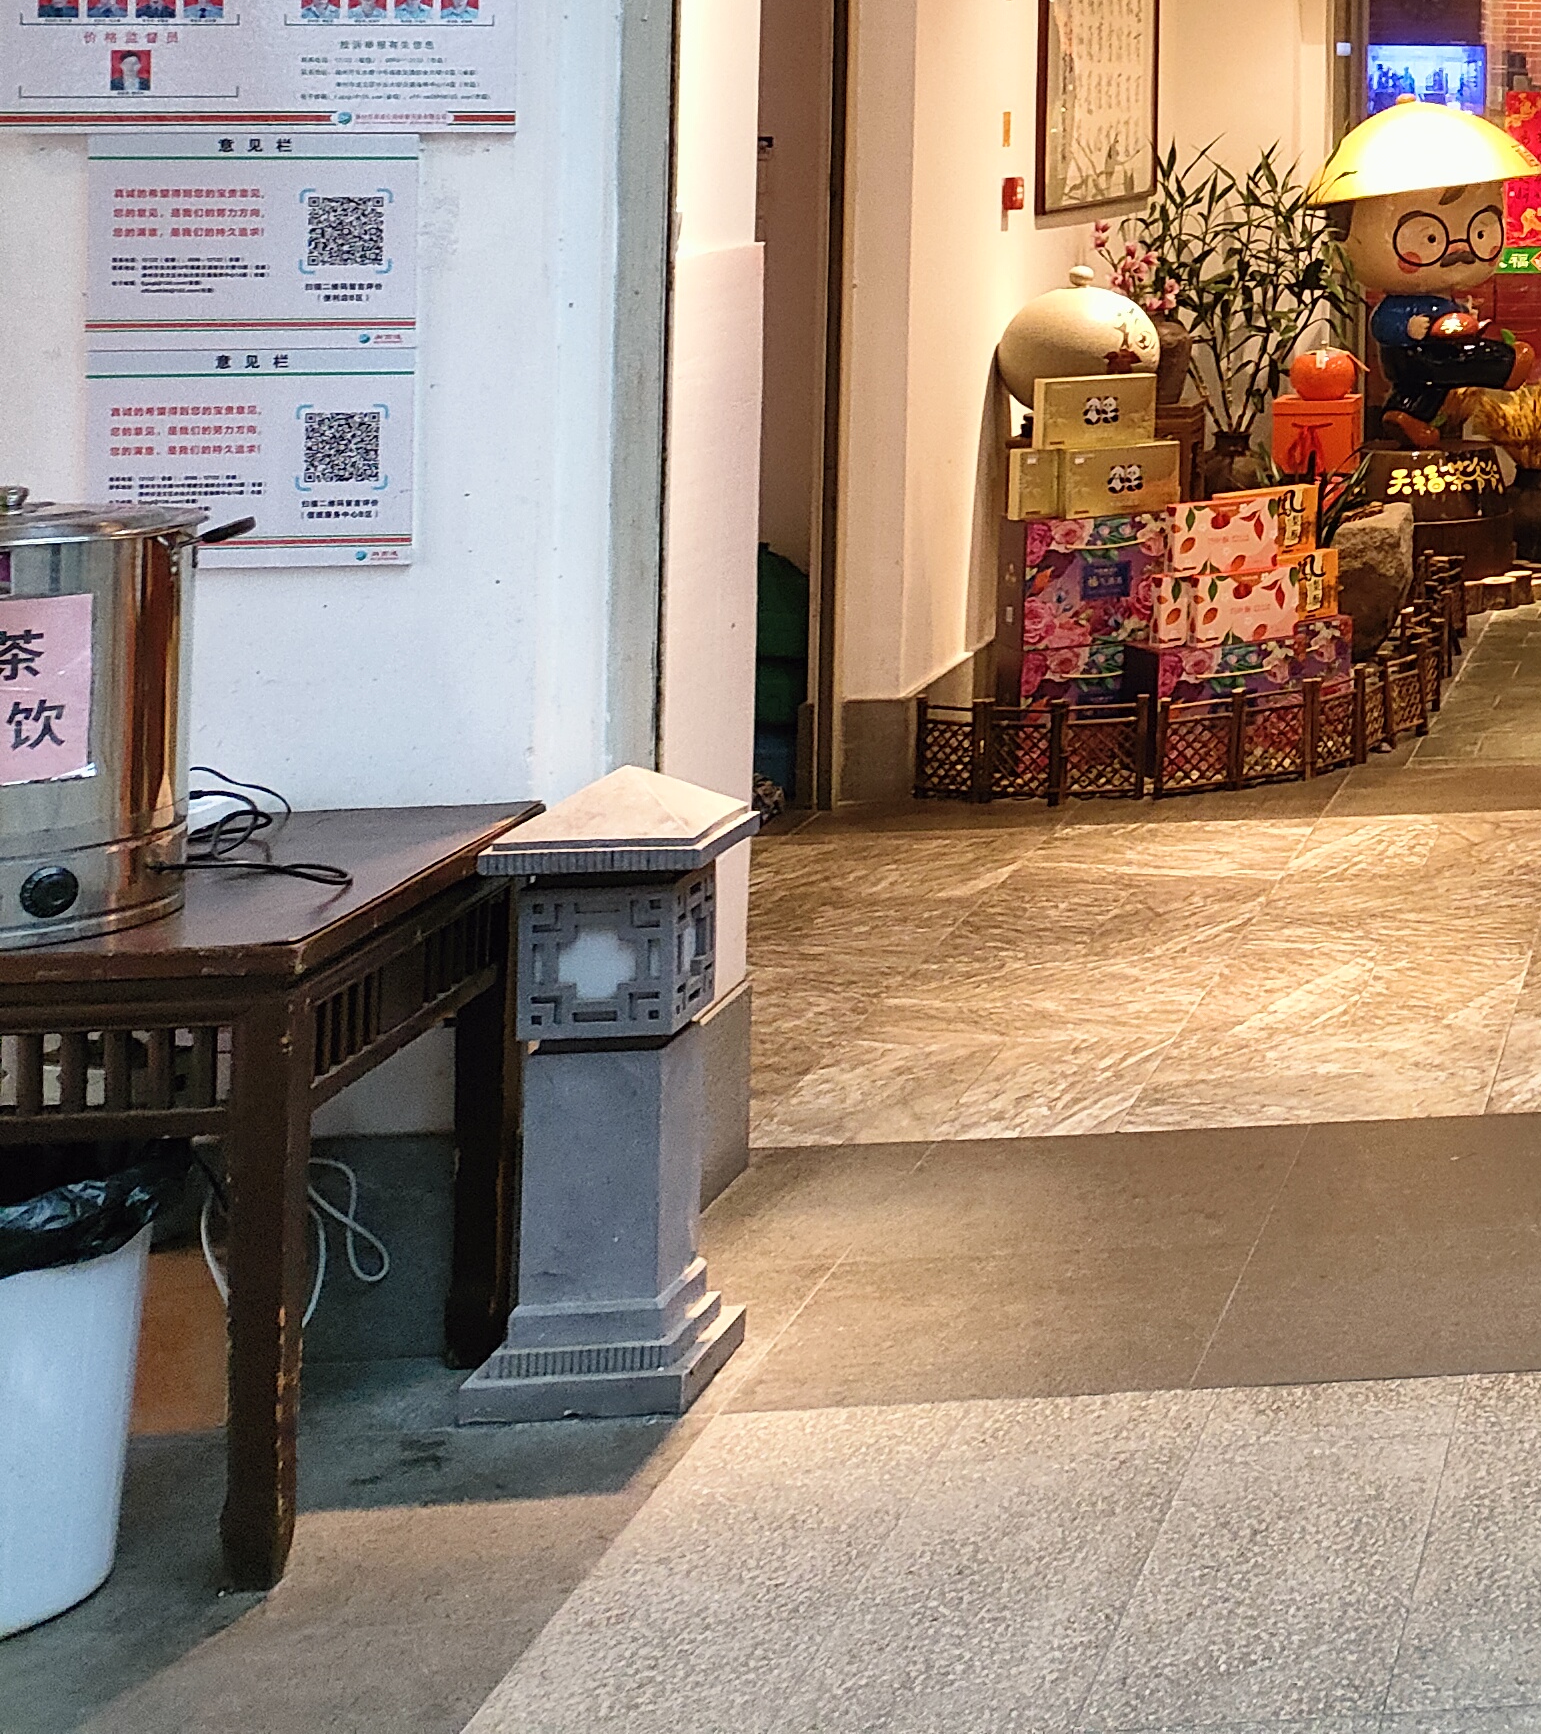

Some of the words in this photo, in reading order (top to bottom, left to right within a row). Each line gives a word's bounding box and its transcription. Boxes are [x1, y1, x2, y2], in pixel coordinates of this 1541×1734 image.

[217, 137, 294, 153] 意见栏
[215, 354, 290, 369] 意见栏
[6, 699, 66, 750] 饮
